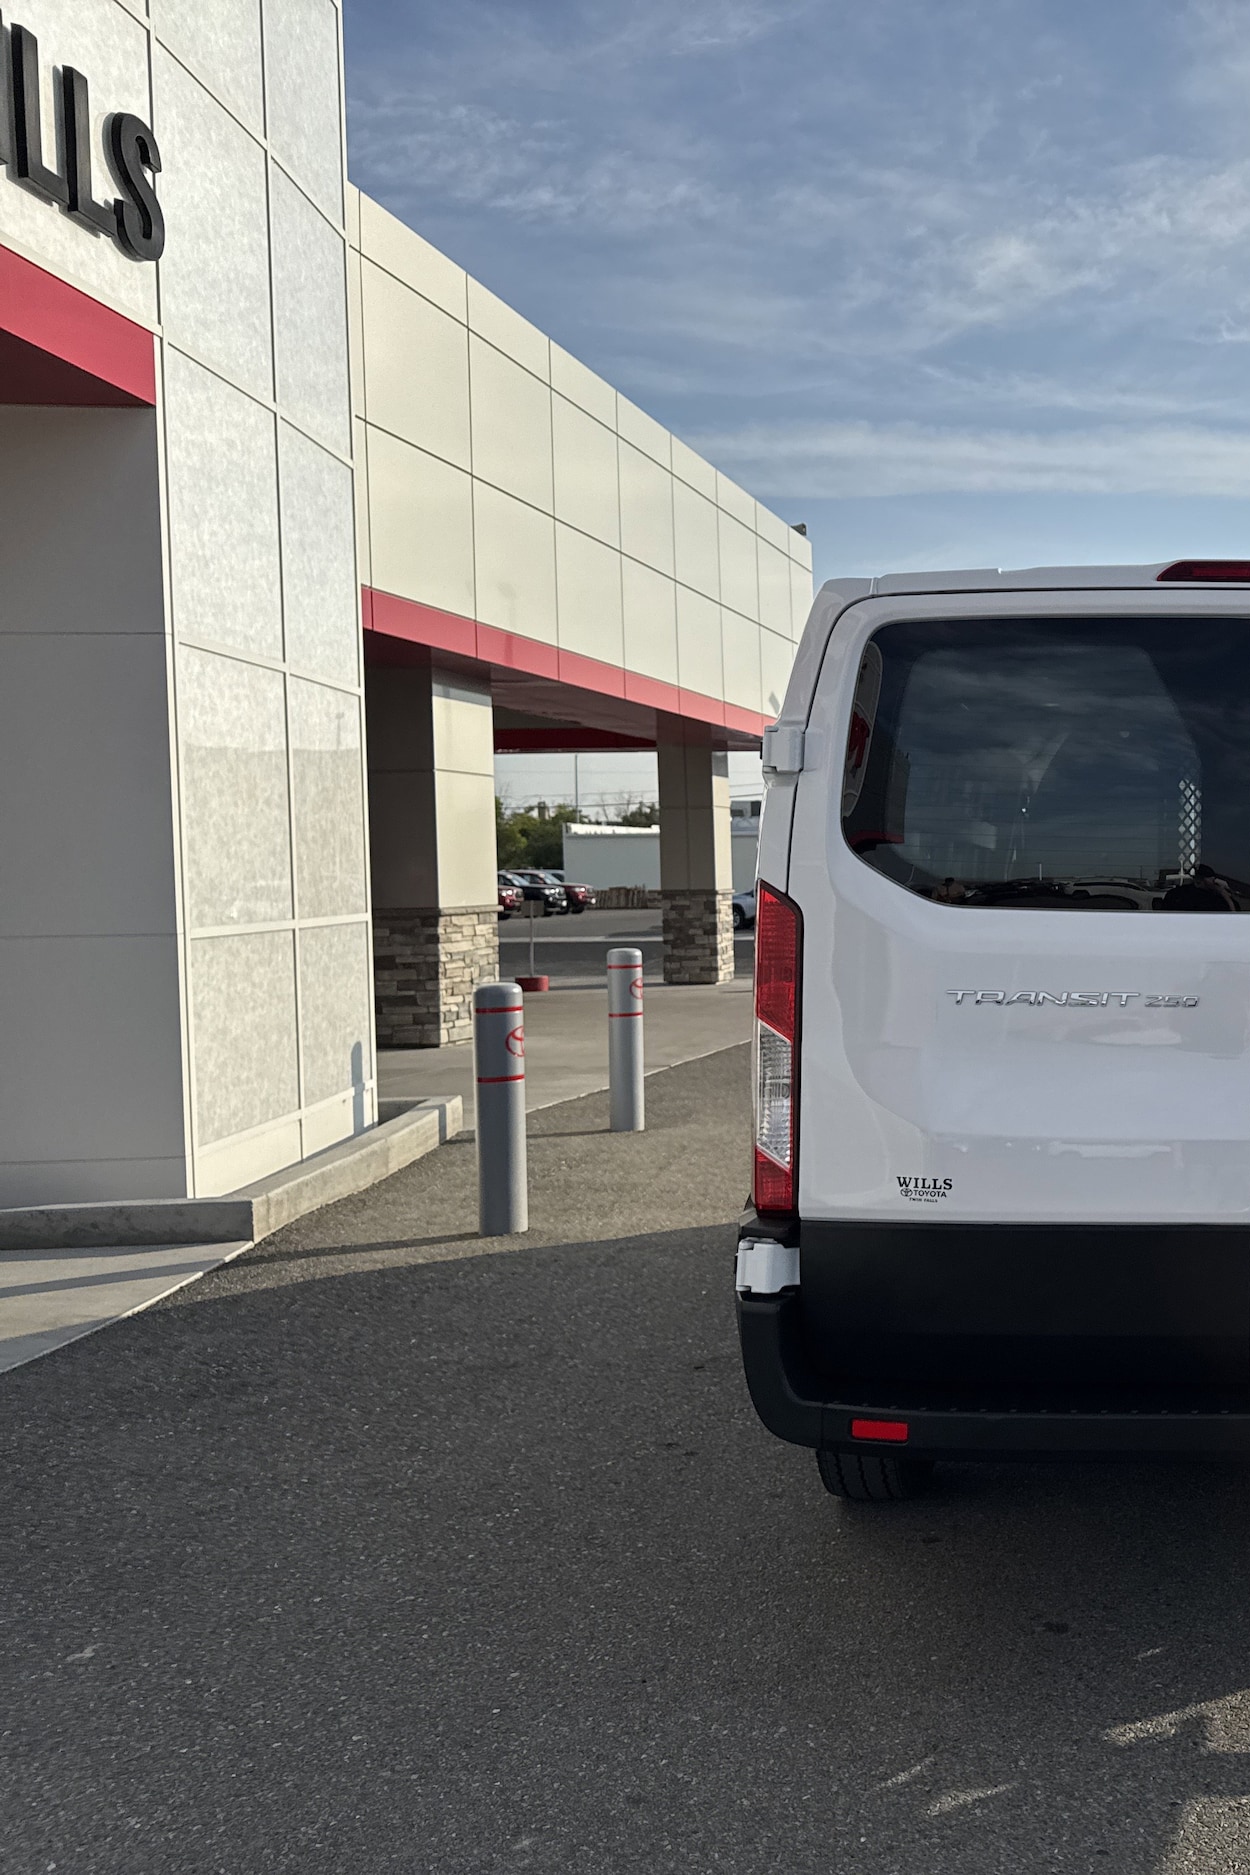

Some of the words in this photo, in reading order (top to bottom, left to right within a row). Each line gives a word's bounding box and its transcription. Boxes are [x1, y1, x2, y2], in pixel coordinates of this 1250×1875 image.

[946, 990, 1140, 1007] TRANSIT
[1145, 995, 1199, 1007] 250
[896, 1176, 953, 1190] WILLS
[913, 1189, 947, 1198] TOYOTA
